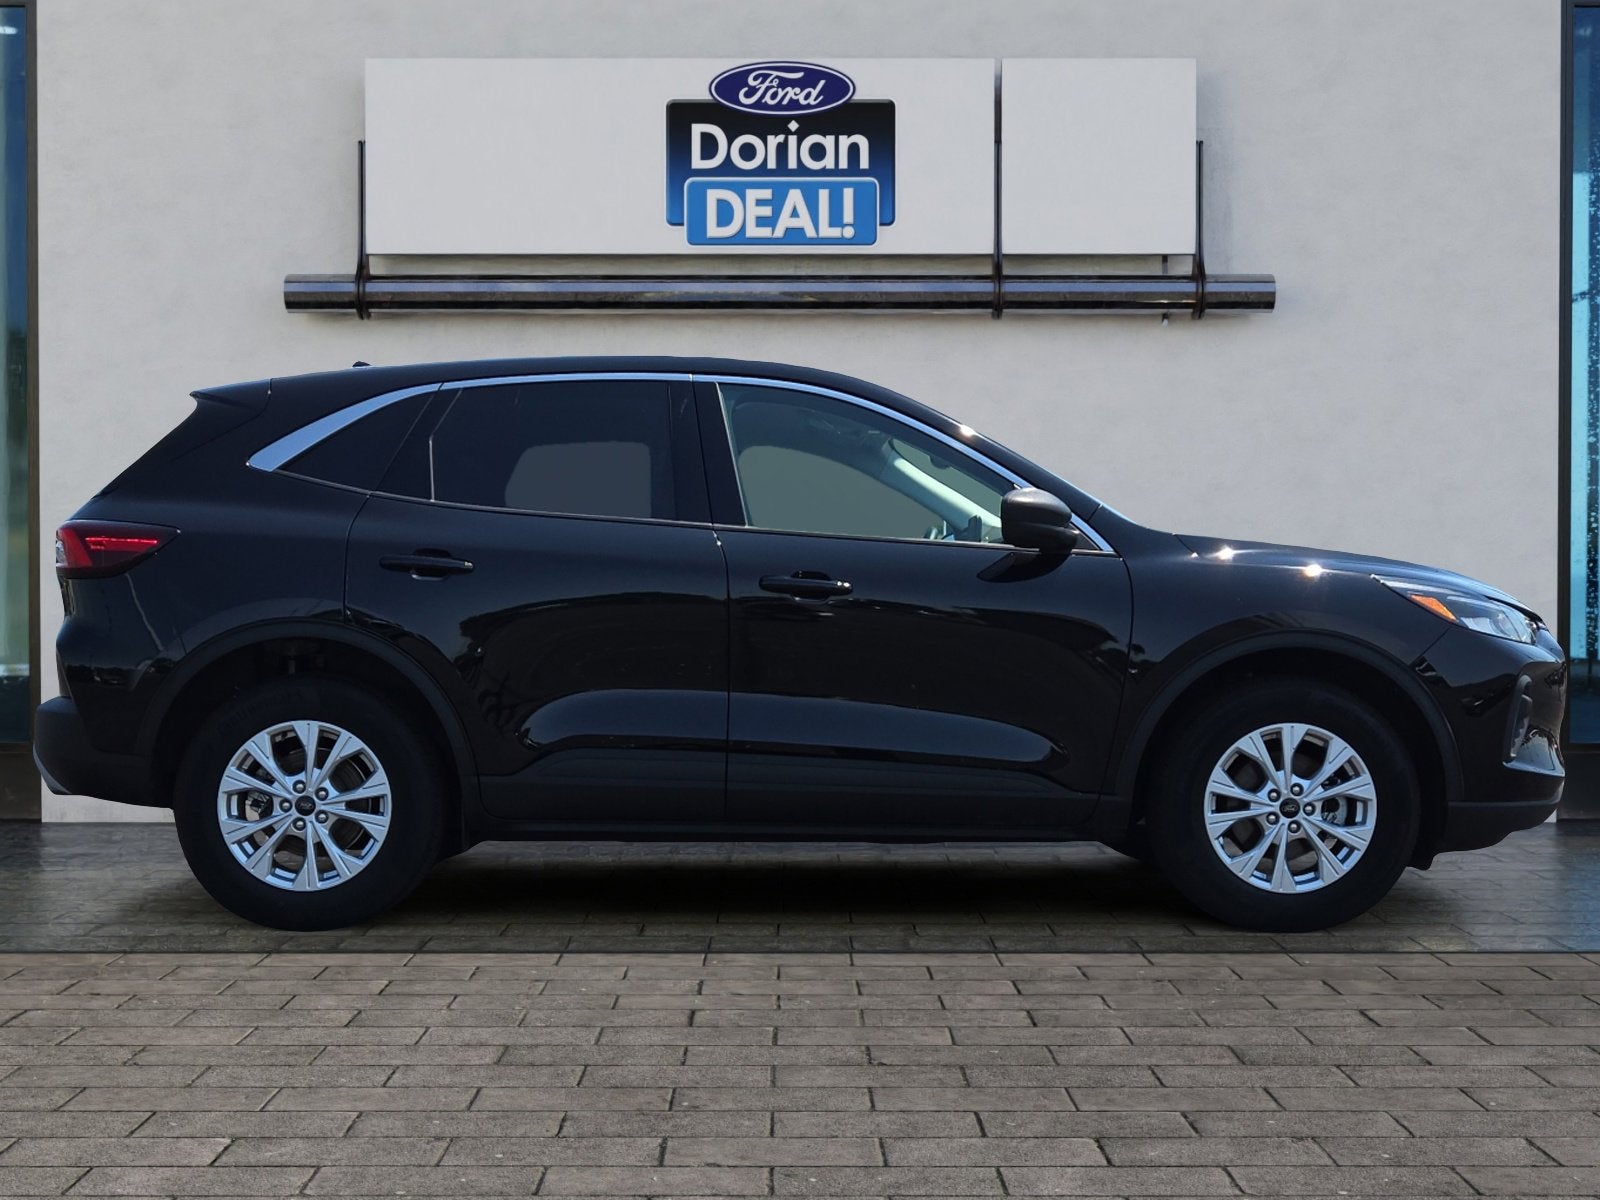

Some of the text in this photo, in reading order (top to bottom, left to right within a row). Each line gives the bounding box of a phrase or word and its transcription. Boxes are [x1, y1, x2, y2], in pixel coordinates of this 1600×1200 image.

[738, 69, 826, 106] Ford
[691, 119, 870, 170] Dorian
[706, 187, 856, 239] DEAL!
